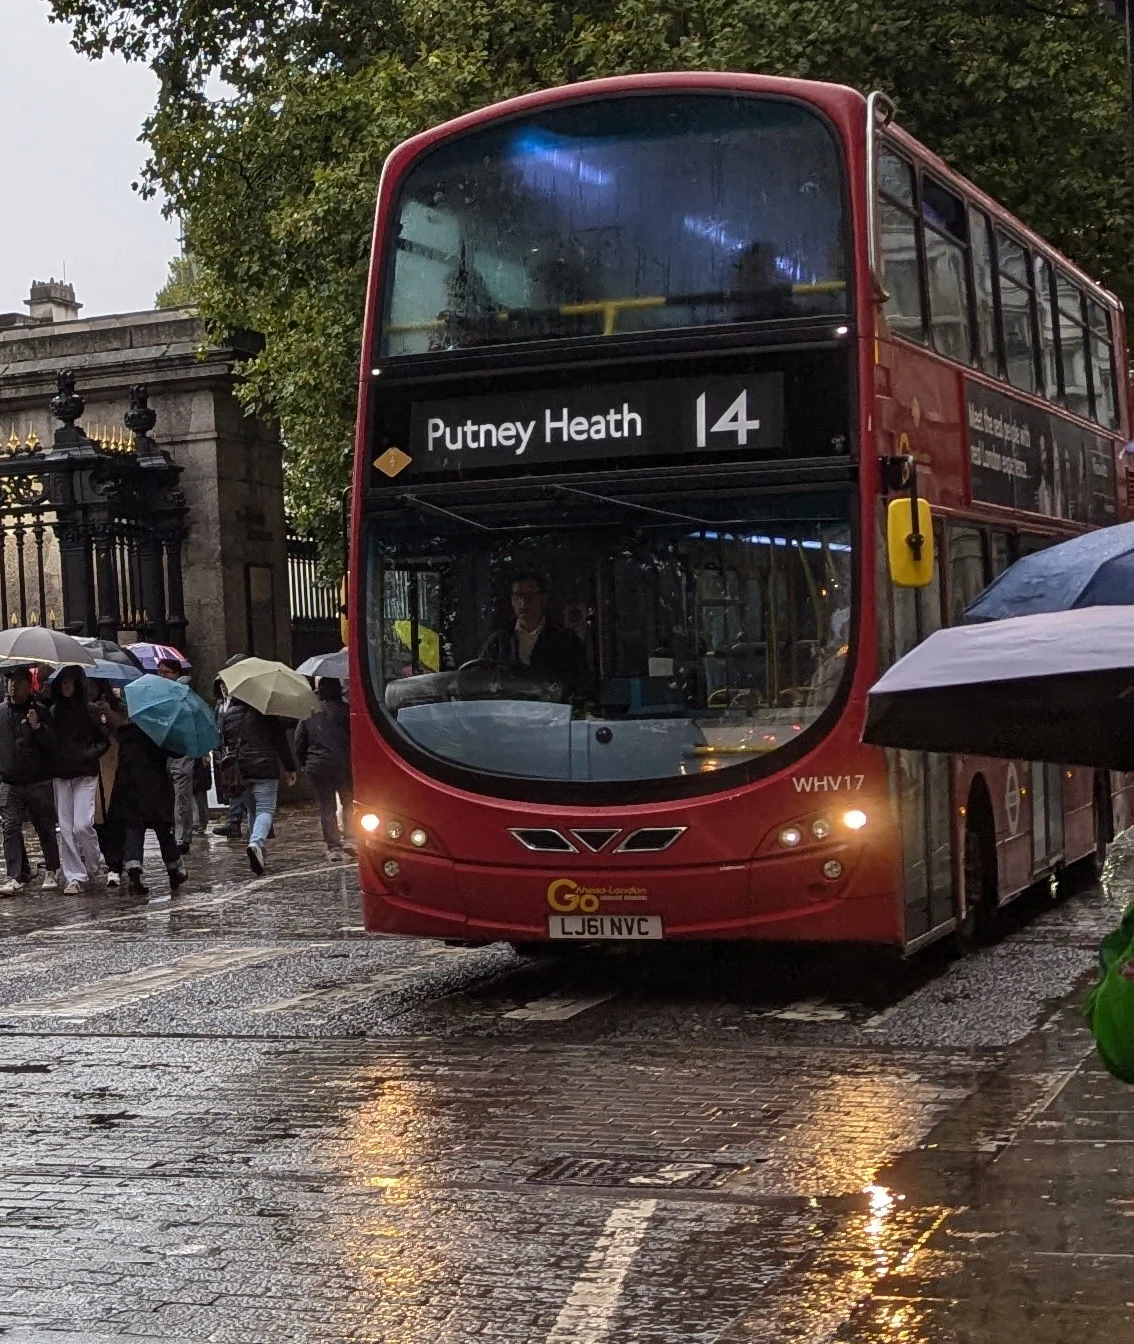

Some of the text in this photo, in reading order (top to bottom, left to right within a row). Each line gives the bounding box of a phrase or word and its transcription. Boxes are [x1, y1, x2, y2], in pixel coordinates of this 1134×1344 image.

[427, 403, 642, 455] Putney Heath
[696, 388, 760, 448] 14
[792, 774, 865, 793] WHV17
[547, 878, 599, 913] Go
[560, 917, 650, 936] LJ61 NVC
